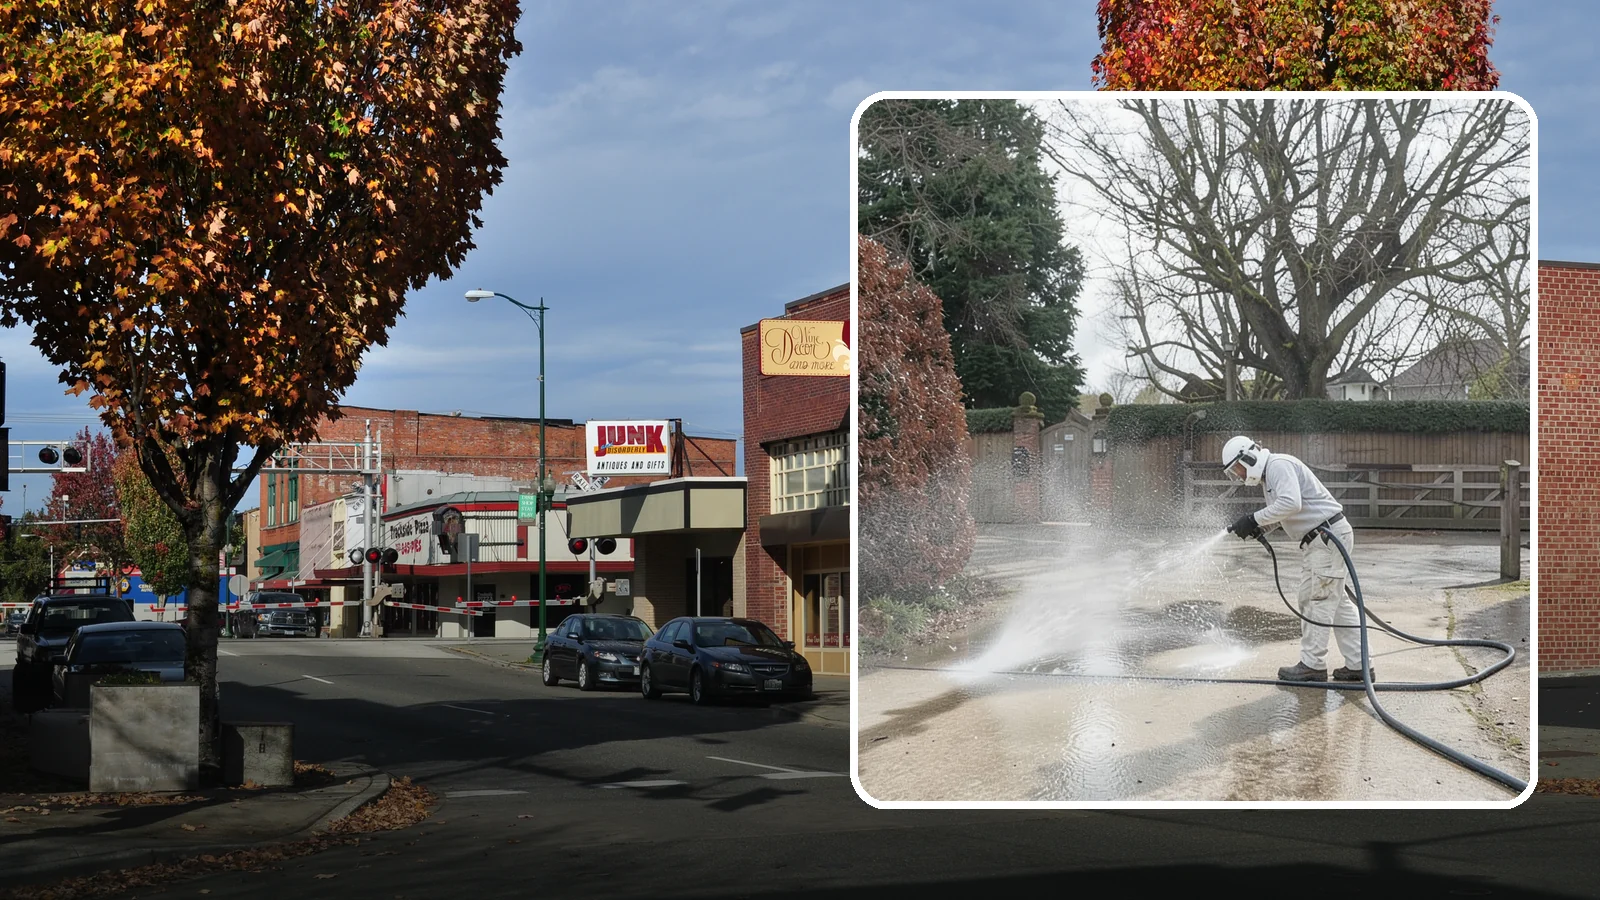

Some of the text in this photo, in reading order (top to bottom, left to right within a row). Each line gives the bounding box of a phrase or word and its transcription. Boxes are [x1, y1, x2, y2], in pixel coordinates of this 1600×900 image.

[765, 328, 831, 365] Decor
[595, 425, 664, 457] JUNK
[607, 446, 645, 454] DISORDERLY
[597, 460, 665, 470] ANTIQUES AND GIFTS
[389, 519, 429, 540] Trackside Pizza
